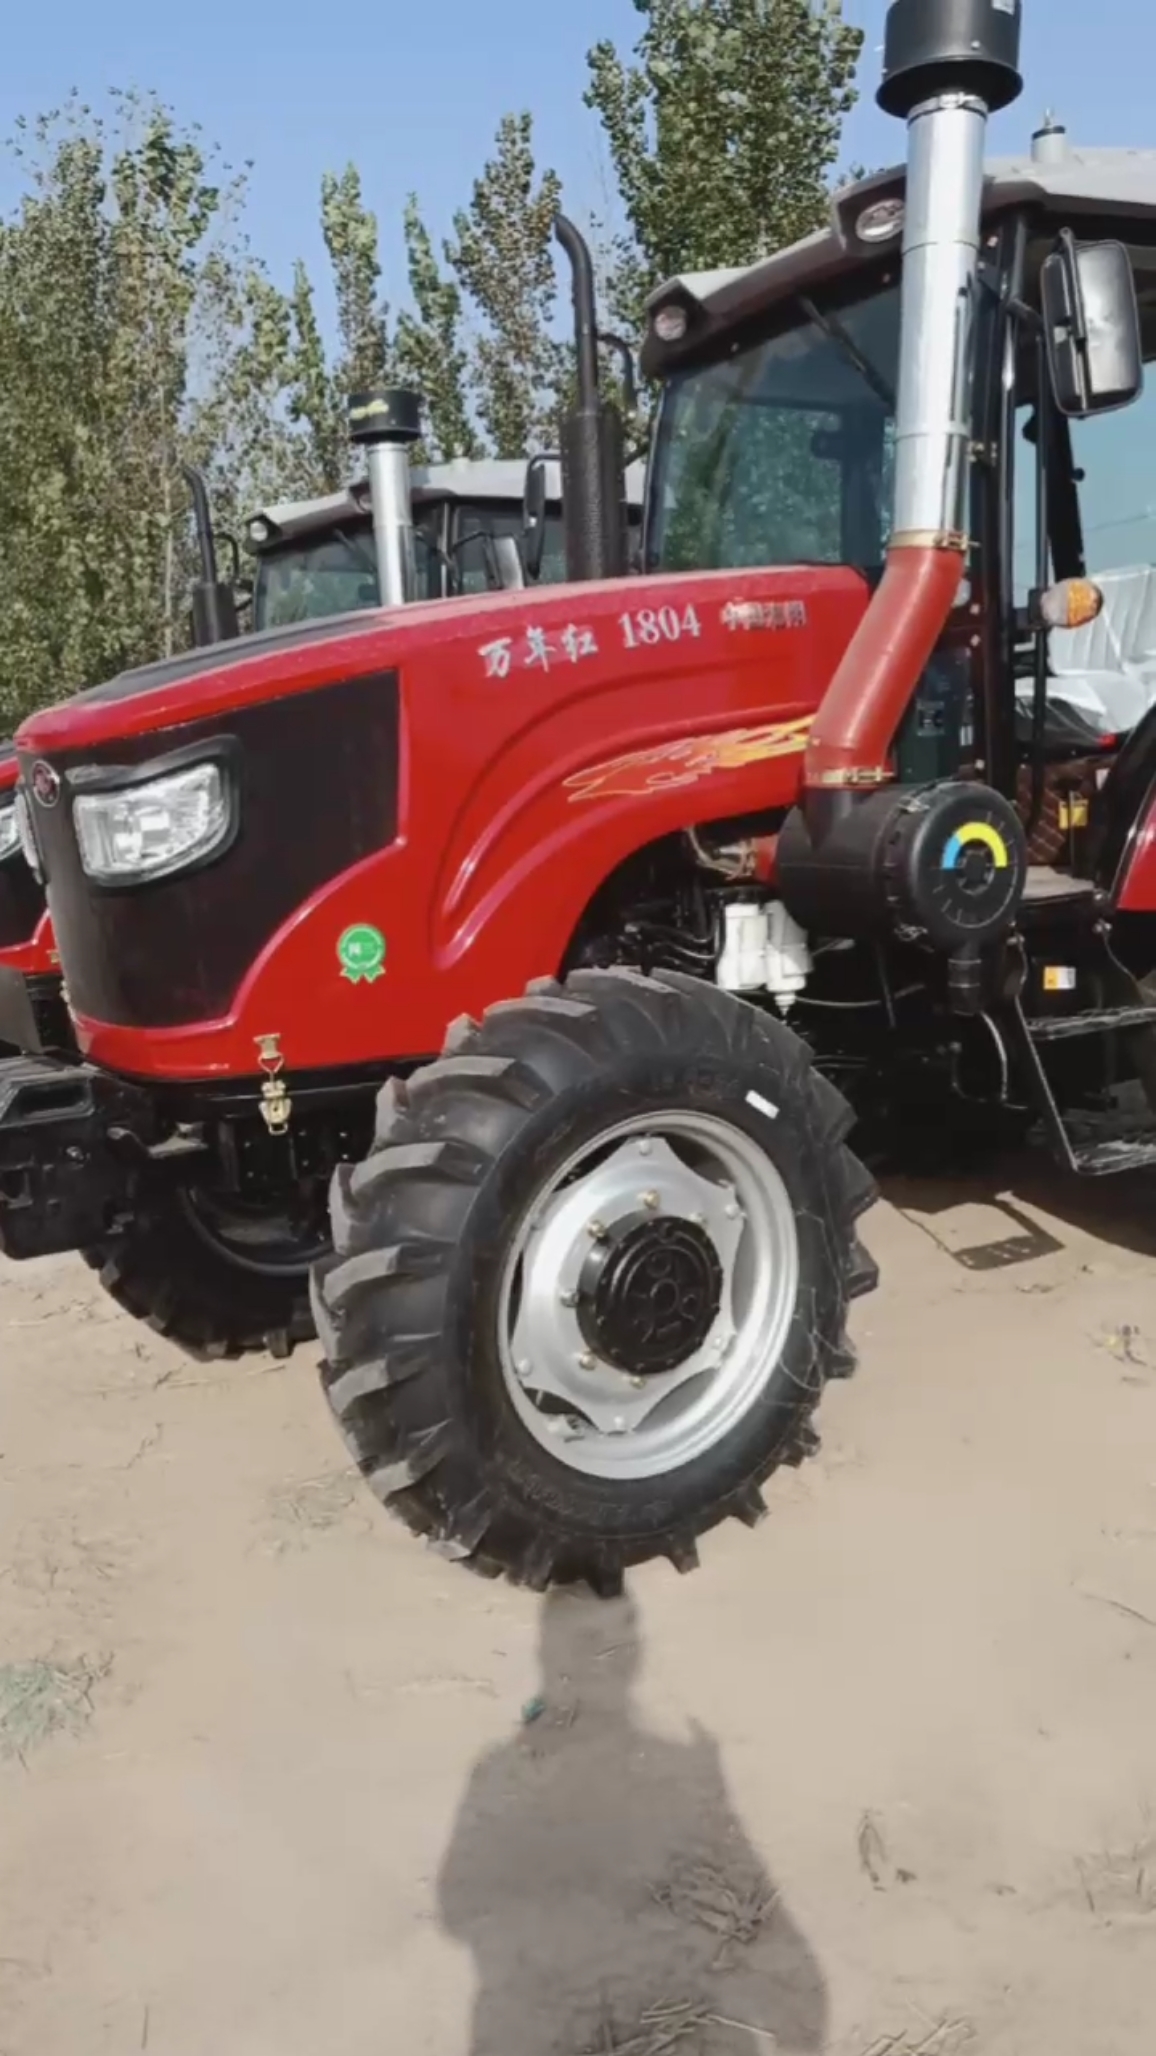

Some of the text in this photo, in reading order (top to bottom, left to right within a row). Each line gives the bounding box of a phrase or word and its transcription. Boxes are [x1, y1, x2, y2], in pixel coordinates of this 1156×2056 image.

[478, 623, 599, 678] 万年红
[618, 603, 701, 649] 1804
